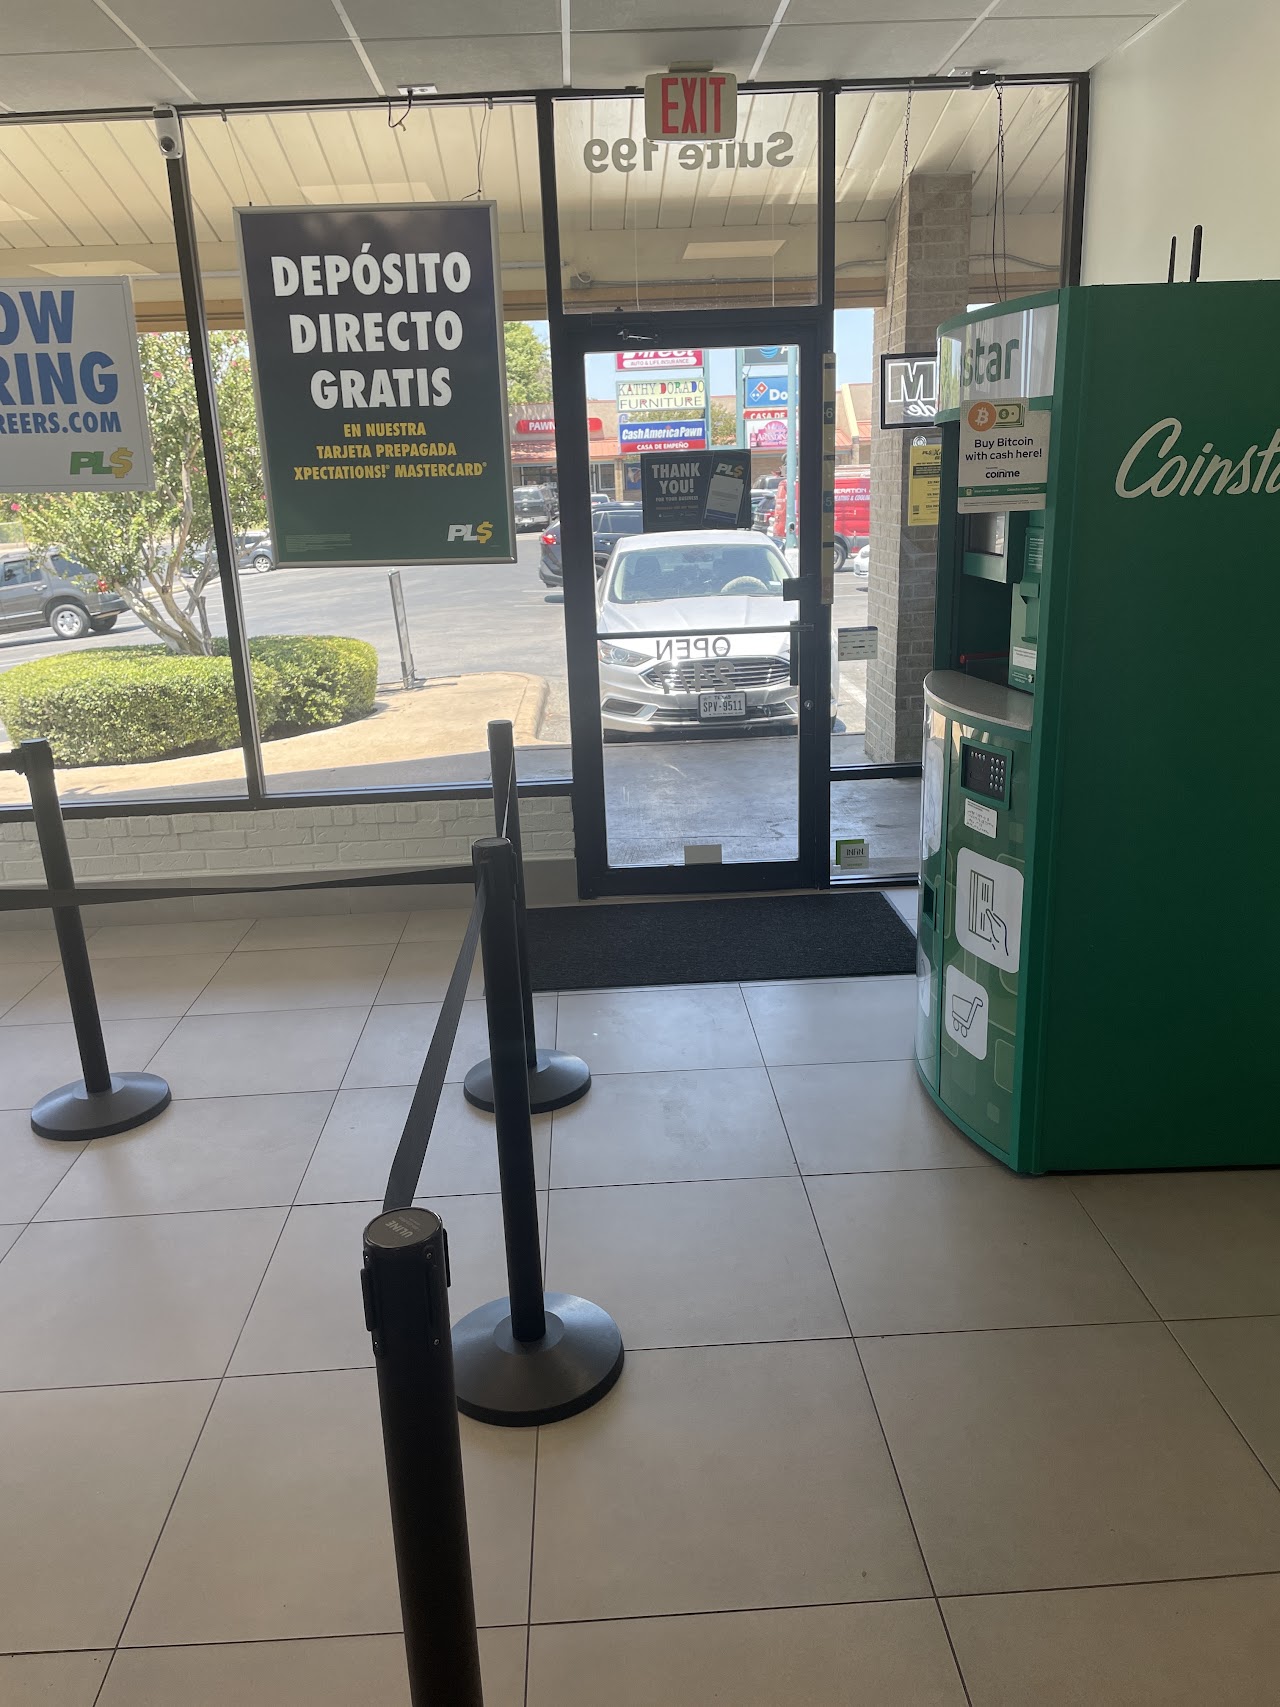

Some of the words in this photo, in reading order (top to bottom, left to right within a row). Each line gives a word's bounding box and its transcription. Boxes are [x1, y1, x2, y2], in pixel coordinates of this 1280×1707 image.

[661, 77, 726, 134] EXIT
[271, 243, 471, 296] DEPÓSITO
[289, 310, 463, 353] DIRECTO
[310, 367, 452, 409] GRATIS
[618, 383, 657, 396] KATHY
[659, 380, 704, 395] DORADO
[620, 396, 702, 410] FURNITURE
[343, 423, 361, 438] EN
[365, 422, 427, 437] NUESTRA
[316, 444, 372, 459] TARJETA
[375, 442, 457, 458] PREPAGADA
[663, 441, 689, 449] EMPEÑO
[974, 439, 995, 450] Buy
[997, 437, 1034, 447] Bitcoin
[966, 451, 988, 461] with
[990, 450, 1014, 460] cash
[1015, 448, 1042, 458] here!
[651, 462, 701, 479] THANK
[985, 469, 1020, 478] coinme
[659, 478, 694, 494] YOU!
